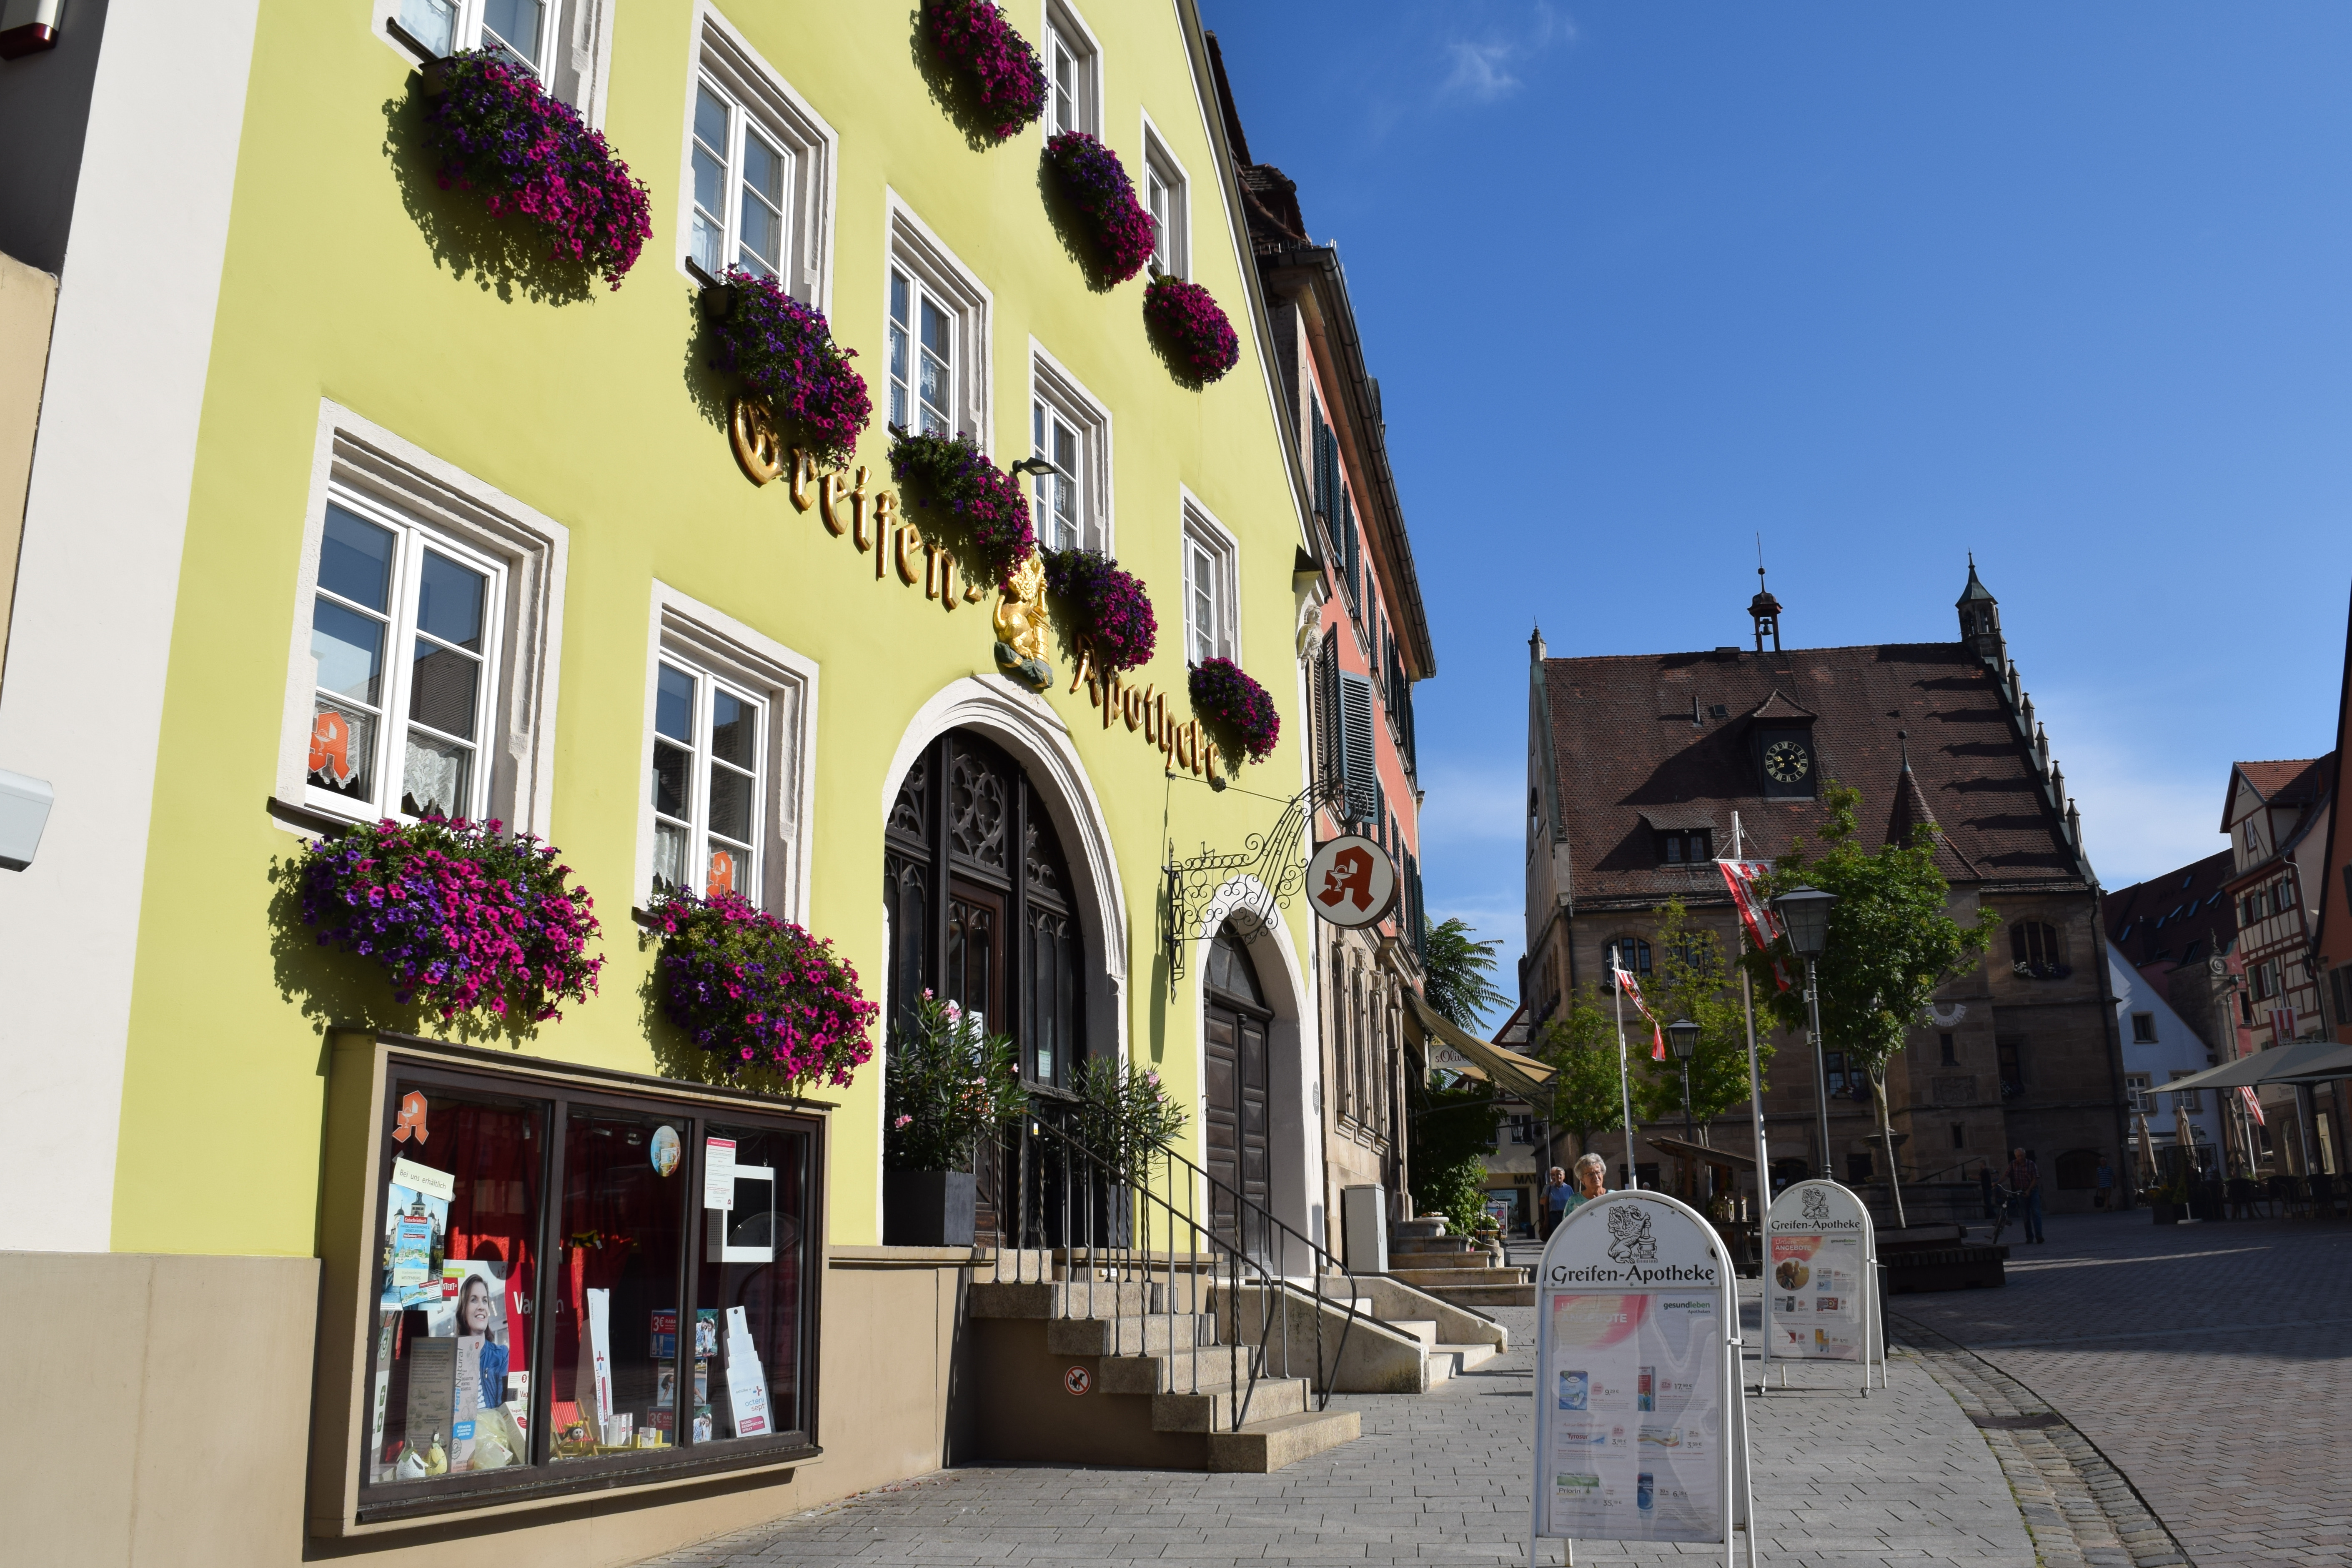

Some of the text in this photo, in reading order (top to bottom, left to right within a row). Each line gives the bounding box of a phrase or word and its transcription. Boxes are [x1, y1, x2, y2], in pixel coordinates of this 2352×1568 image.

[1435, 1050, 1467, 1063] s.Olive
[400, 1169, 408, 1177] Bei
[422, 1178, 446, 1190] erhältlich
[1771, 1220, 1860, 1230] Greifen-Apotheke
[1551, 1264, 1715, 1284] Greifen-Apotheke
[1663, 1301, 1710, 1310] gesundleben
[745, 1396, 764, 1407] octeni
